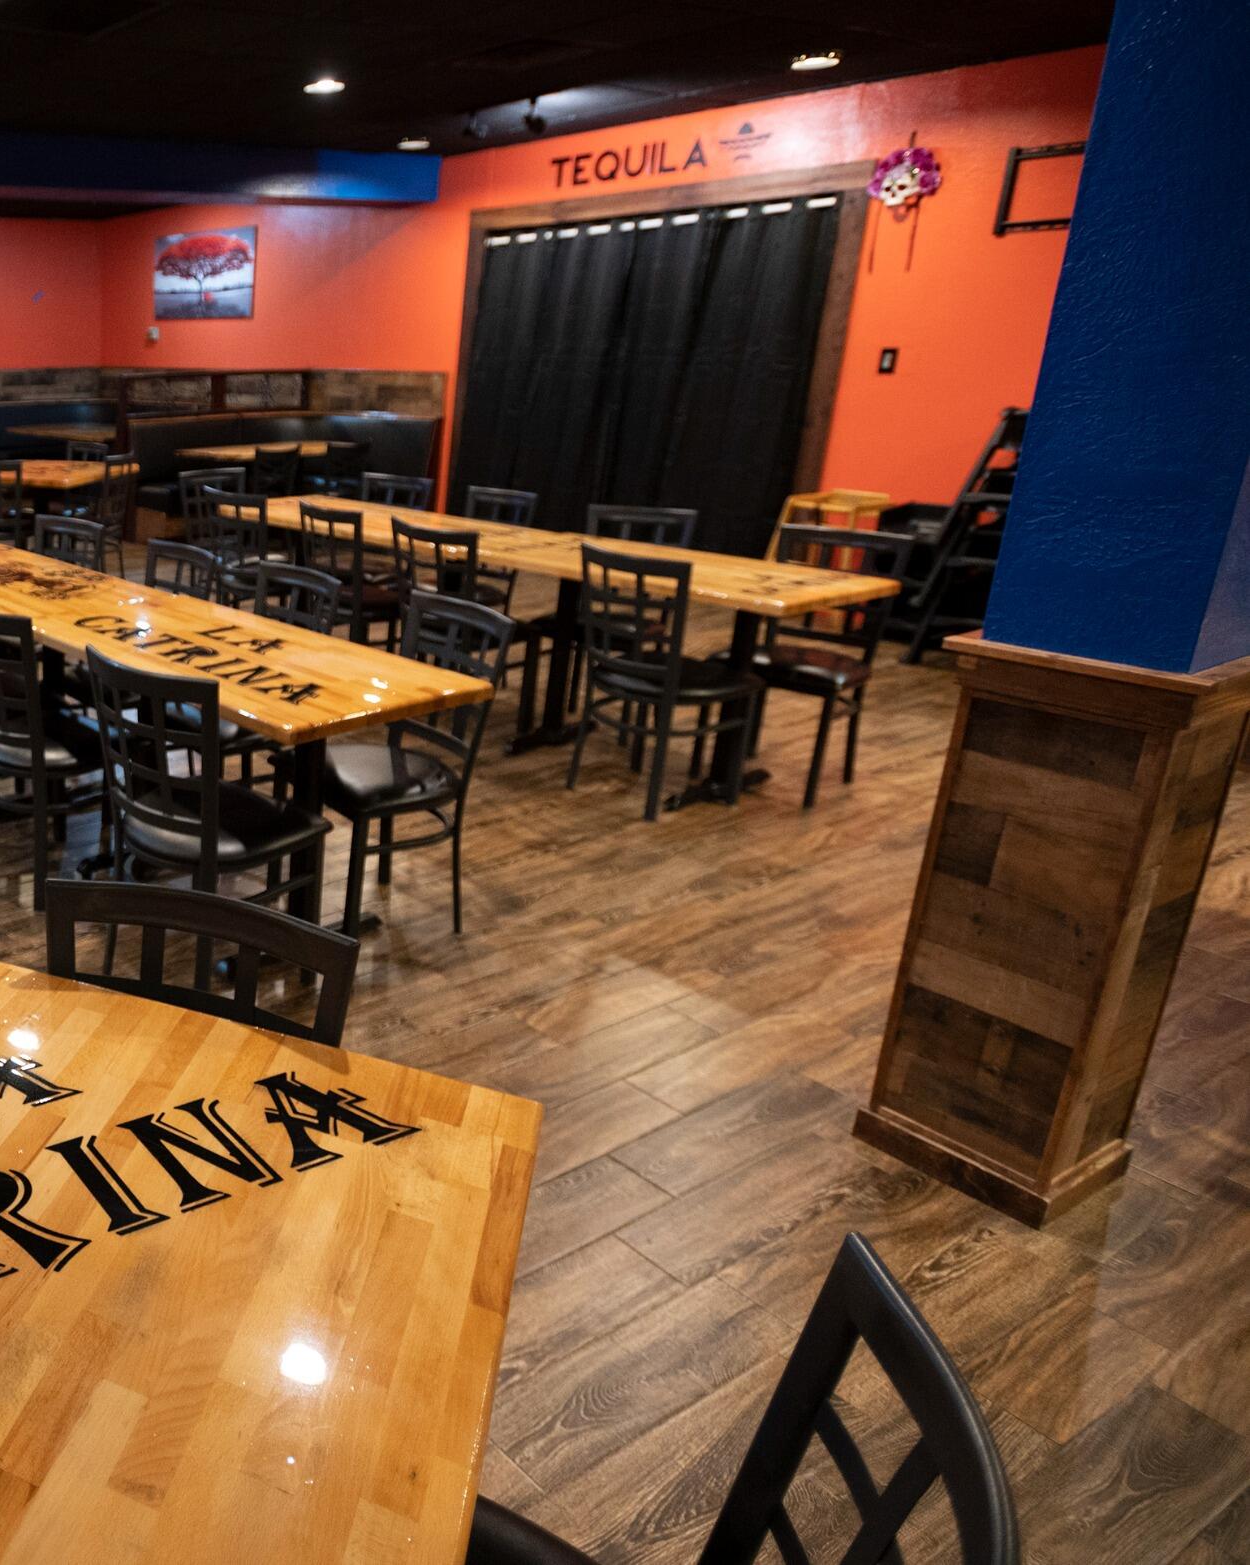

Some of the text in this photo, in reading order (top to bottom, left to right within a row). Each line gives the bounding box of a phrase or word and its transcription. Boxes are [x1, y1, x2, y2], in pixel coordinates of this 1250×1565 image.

[551, 138, 707, 188] TEQUILA
[73, 615, 321, 705] CATRINA
[195, 625, 286, 655] LA
